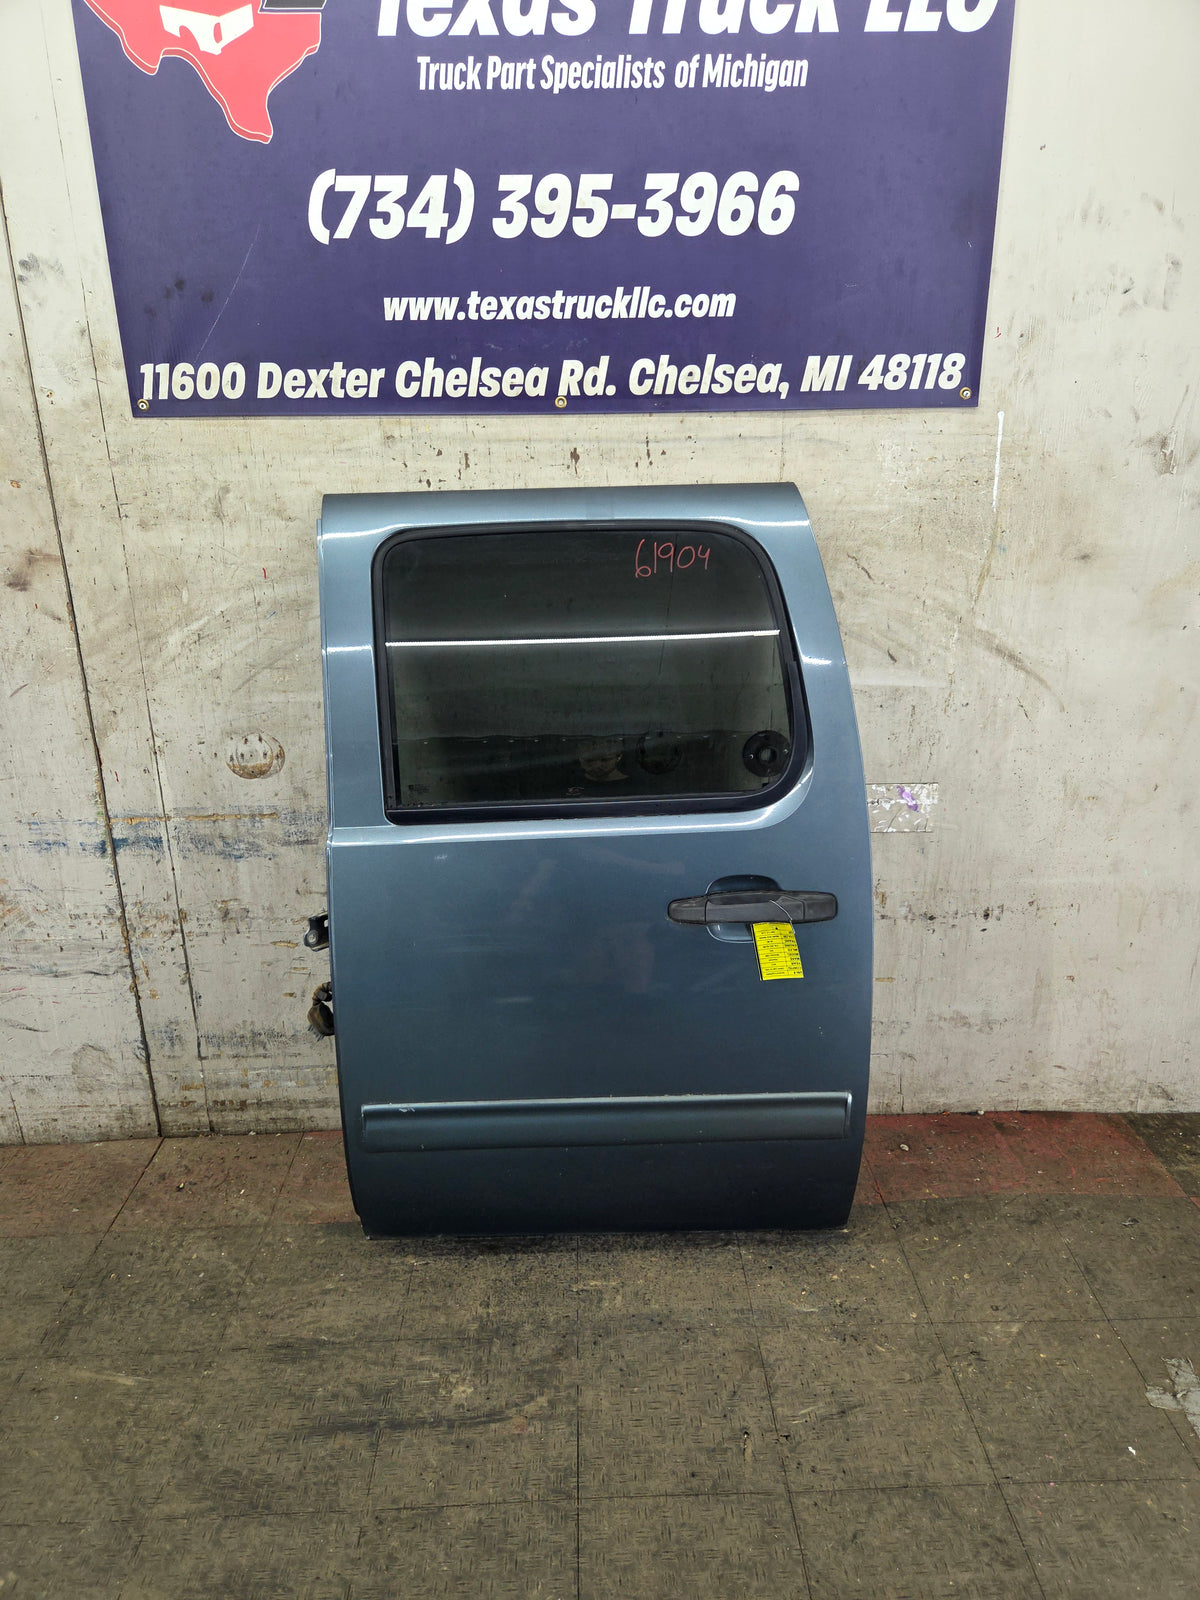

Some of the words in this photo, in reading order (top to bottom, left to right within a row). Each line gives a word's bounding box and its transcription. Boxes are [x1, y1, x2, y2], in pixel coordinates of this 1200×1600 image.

[417, 55, 482, 91] Truck
[486, 55, 537, 91] Part
[539, 54, 665, 95] Specialists
[674, 53, 701, 89] of
[701, 52, 808, 93] Michigan
[308, 167, 475, 245] (734)
[491, 170, 800, 239] 395-3966
[383, 286, 737, 321] www.texastruckllc.com
[138, 362, 246, 400] 11600
[256, 361, 386, 400] Dexter
[395, 356, 550, 398] Chelsea
[557, 355, 617, 397] Rd.
[628, 353, 790, 400] Chelsea,
[800, 354, 854, 392] MI
[857, 352, 966, 391] 48118
[635, 539, 711, 578] 61904
